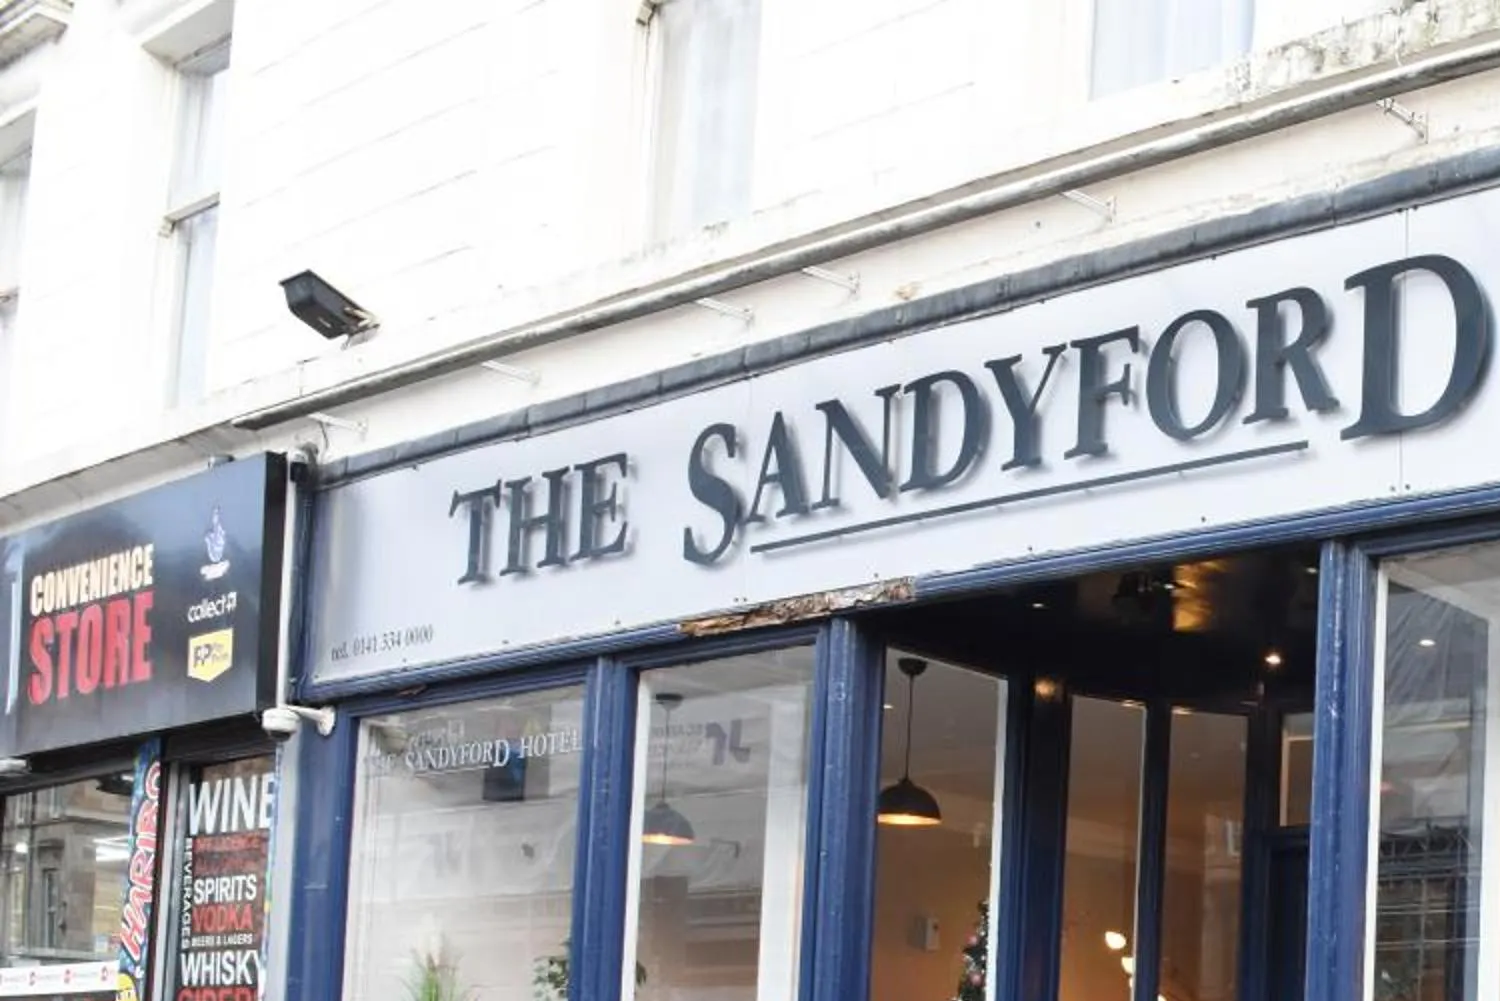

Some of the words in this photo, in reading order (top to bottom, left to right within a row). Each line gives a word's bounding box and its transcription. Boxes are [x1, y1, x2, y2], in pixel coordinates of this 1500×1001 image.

[449, 453, 628, 585] THE
[683, 254, 1493, 565] SANDYFORD
[31, 543, 155, 616] CONVENIENCE
[28, 591, 155, 705] STORE
[405, 739, 510, 773] SANDYFORD
[518, 730, 583, 759] HOTEL
[181, 838, 193, 950] BEVERAGES
[192, 903, 253, 934] VODKA
[193, 873, 257, 905] SPIRITS
